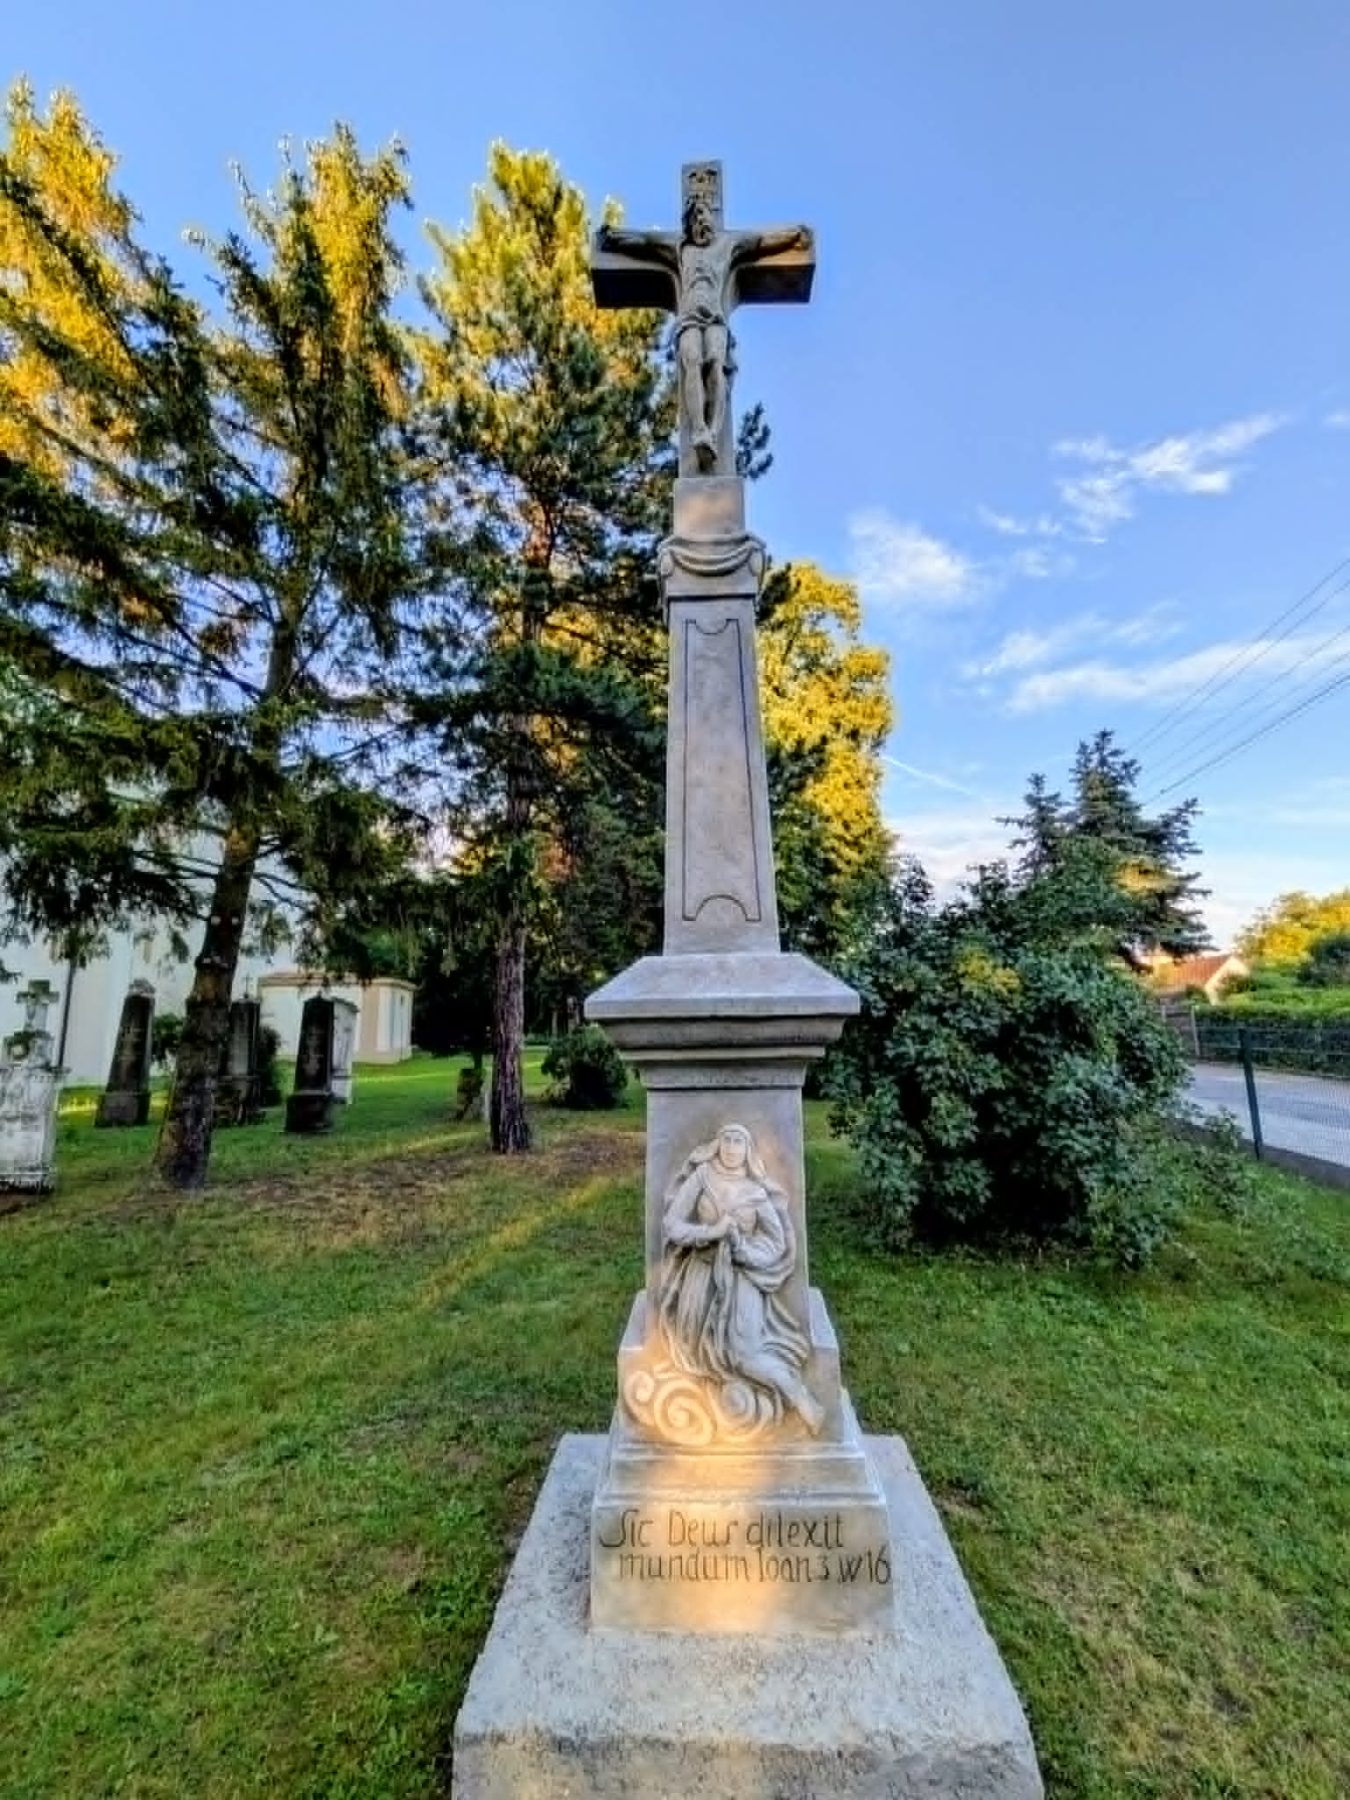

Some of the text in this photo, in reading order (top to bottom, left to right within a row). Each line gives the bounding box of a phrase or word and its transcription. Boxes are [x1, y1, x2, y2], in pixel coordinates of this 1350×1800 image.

[598, 1508, 844, 1550] Sic Deus dilexit
[619, 1547, 751, 1582] mundum
